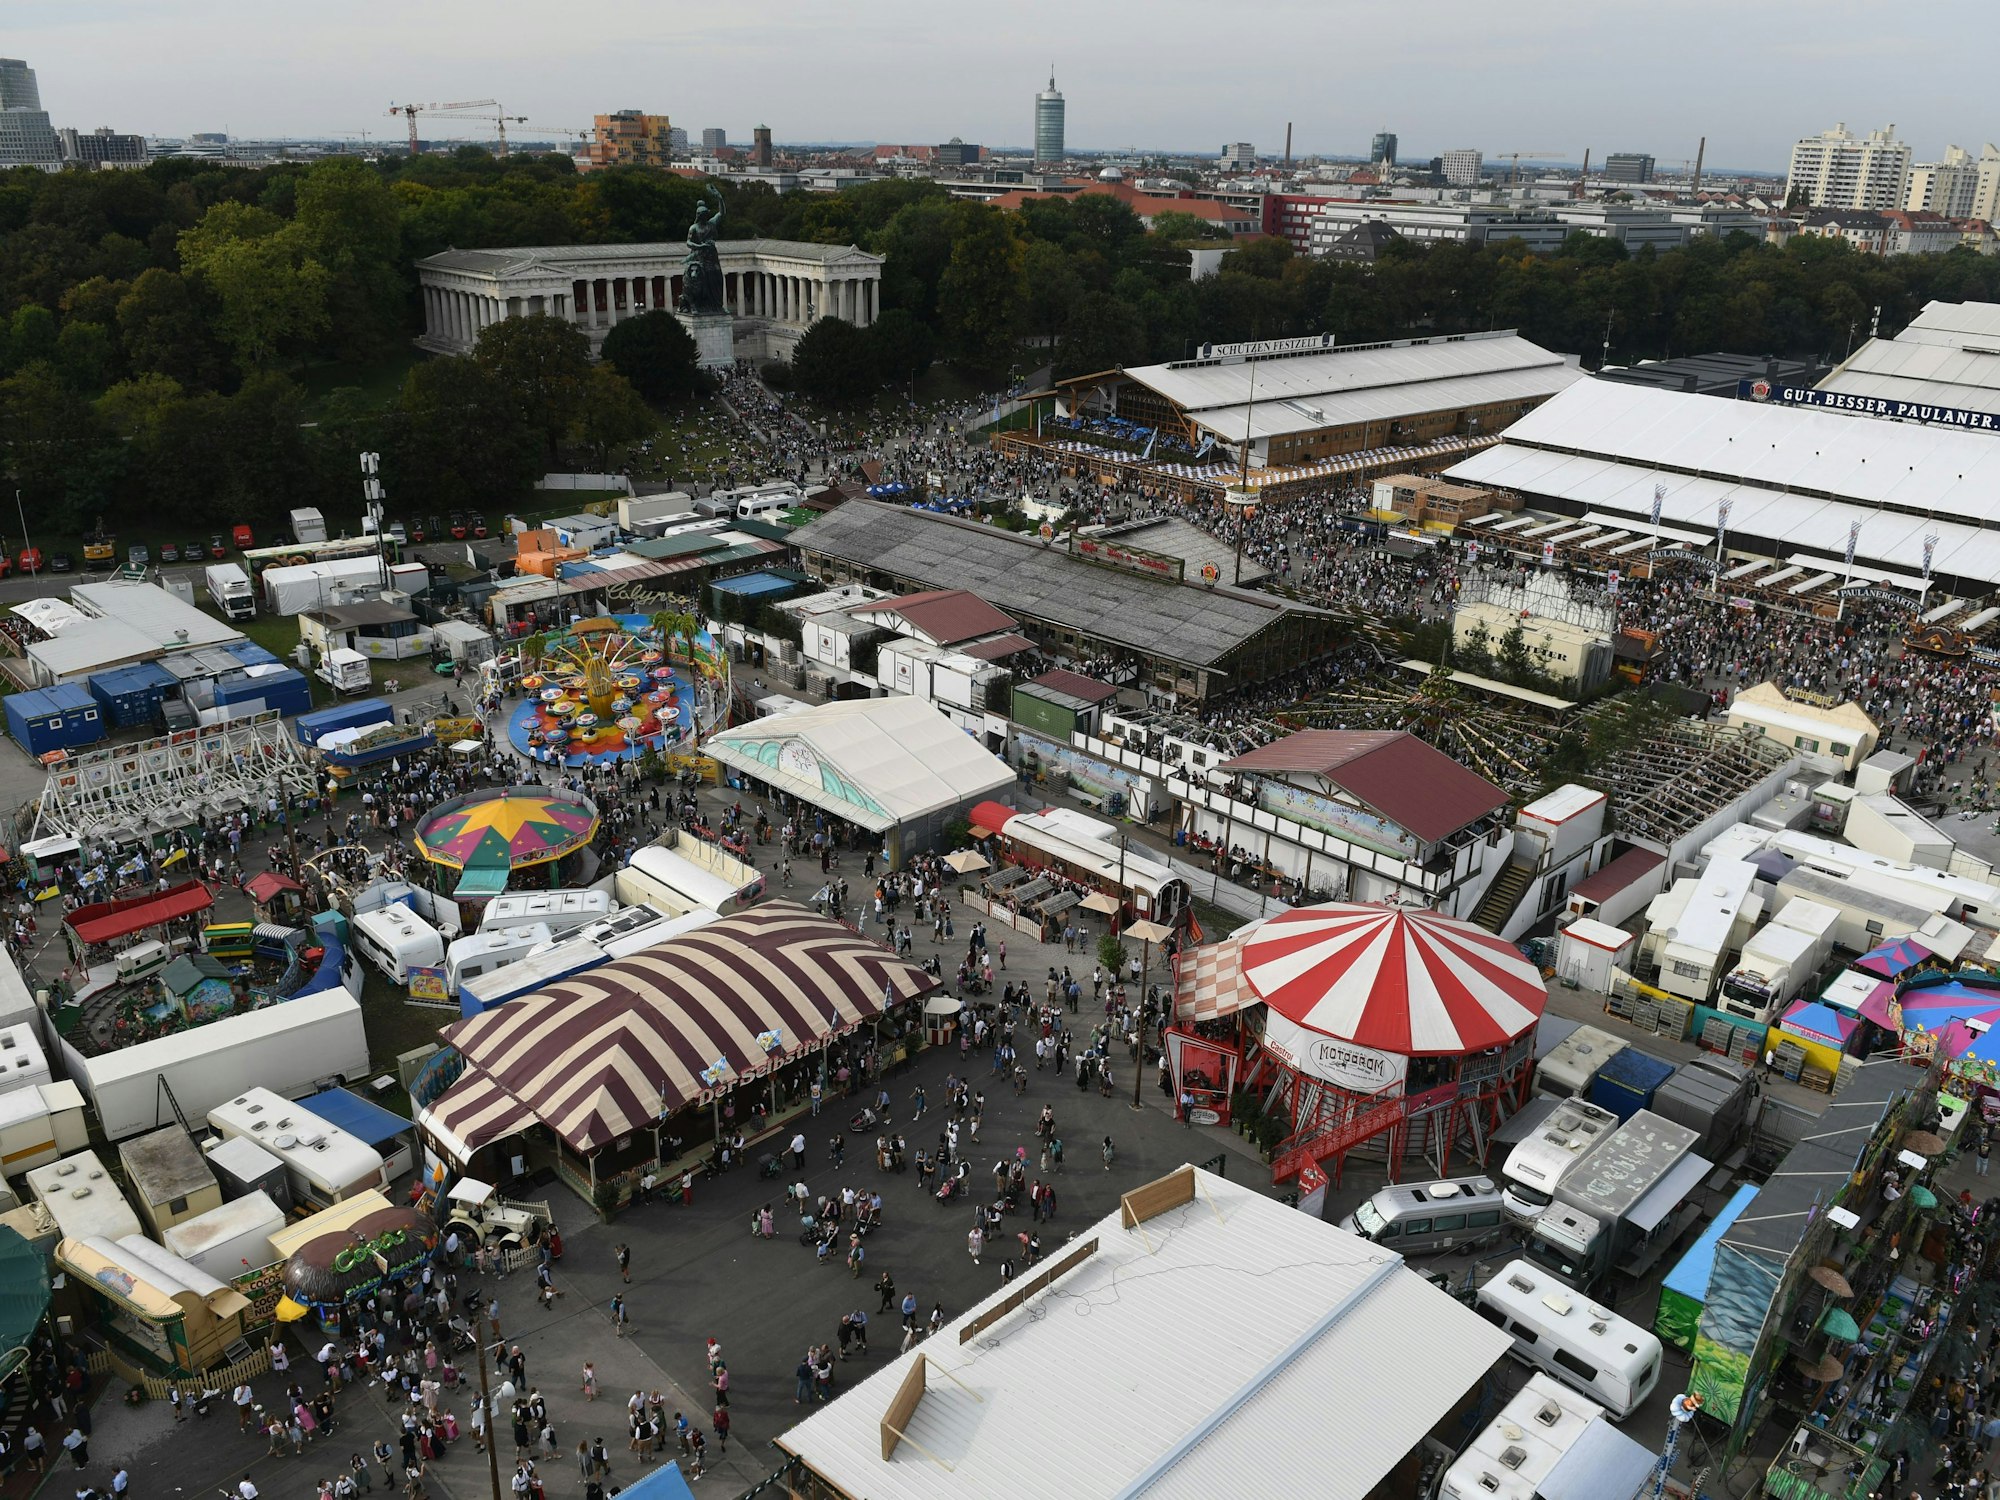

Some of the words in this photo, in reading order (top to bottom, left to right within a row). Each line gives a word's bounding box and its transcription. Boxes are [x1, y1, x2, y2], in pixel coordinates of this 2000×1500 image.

[1273, 337, 1318, 350] FESTZELT
[1783, 388, 1820, 406] GUT,
[1825, 393, 1893, 415] BESSER,
[1897, 403, 1998, 429] PAULANER.
[1649, 550, 1722, 572] PAULANERGARTEN
[606, 582, 690, 606] Calypso
[1840, 588, 1924, 614] PAULANERGARTEN
[1270, 1040, 1294, 1062] Castrol
[1319, 1043, 1384, 1078] MOTODROM
[697, 1078, 739, 1108] Der
[250, 1273, 281, 1290] COCOS
